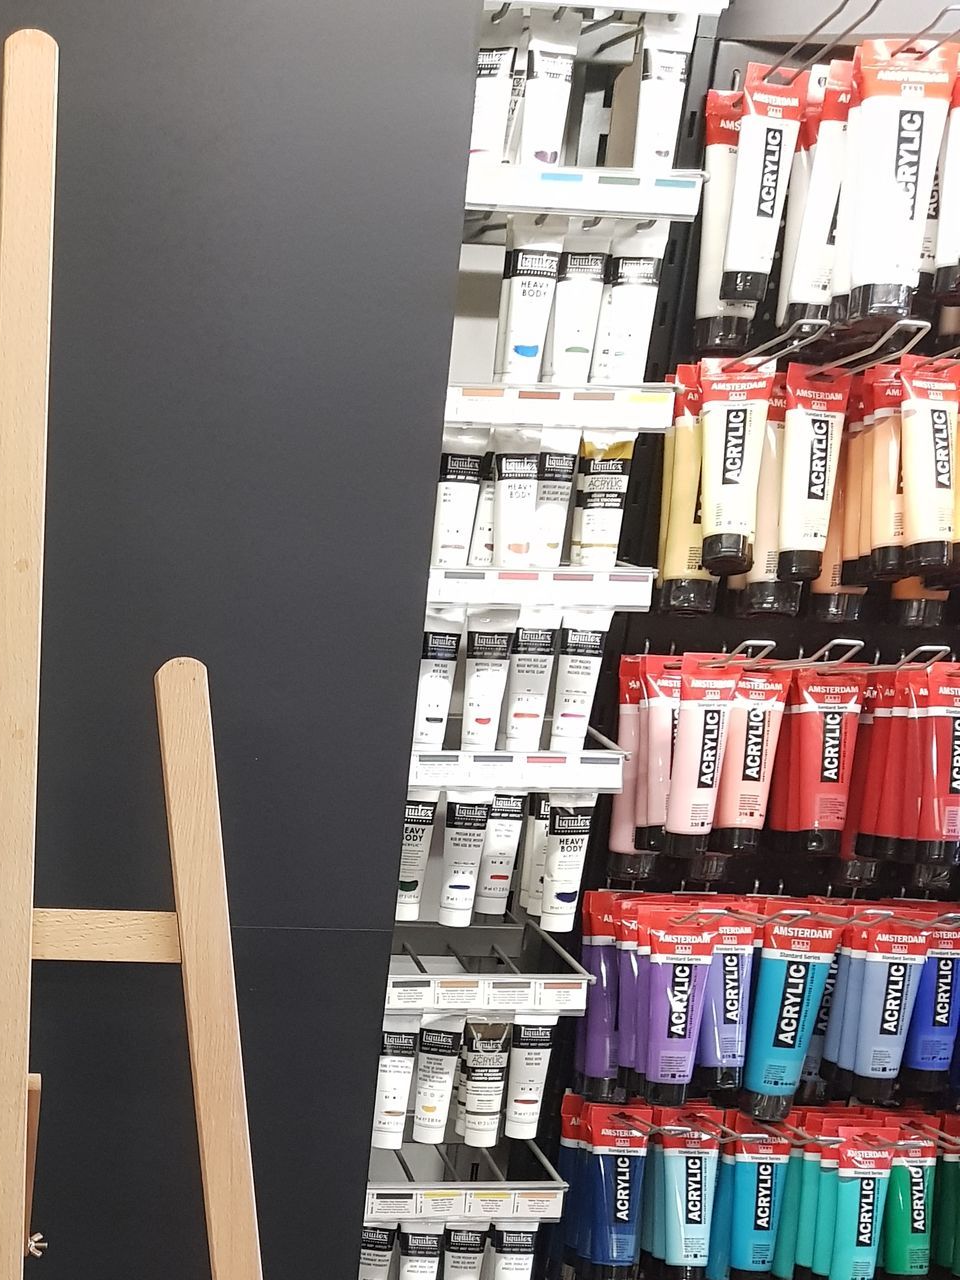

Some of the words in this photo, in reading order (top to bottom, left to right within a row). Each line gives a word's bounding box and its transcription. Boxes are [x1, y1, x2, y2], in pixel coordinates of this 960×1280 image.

[759, 130, 782, 214] ACRYLIC
[711, 381, 766, 391] AMSTERDAM
[796, 389, 843, 401] AMSTERDAM
[725, 411, 747, 483] ACRYLIC
[934, 410, 950, 486] ACRYLIC
[448, 456, 480, 469] Liquitex
[545, 454, 577, 469] Liquitex
[590, 459, 622, 472] Liquitex
[810, 420, 828, 498] ACRYLIC
[588, 480, 622, 489] ACRYLIC
[429, 634, 457, 648] Liquitex
[475, 633, 508, 648] Liquitex
[519, 628, 552, 643] Liquitex
[567, 630, 601, 644] Liquitex
[808, 686, 859, 694] AMSTERDAM
[701, 712, 720, 785] ACRYLIC
[746, 709, 765, 779] ACRYLIC
[824, 713, 841, 780] ACRYLIC
[492, 796, 522, 809] Liquitex
[455, 805, 488, 818] Liquitex
[555, 815, 591, 829] Liquitex
[659, 935, 711, 944] AMSTERDAM
[773, 926, 832, 939] AMSTERDAM
[876, 933, 926, 944] AMSTERDAM
[725, 955, 738, 1021] ACRYLIC
[935, 959, 952, 1024] ACRYLIC
[671, 965, 690, 1036] ACRYLIC
[778, 963, 806, 1044] ACRYLIC
[883, 964, 904, 1032] ACRYLIC
[384, 1033, 414, 1045] Liquitex
[422, 1031, 452, 1044] Liquitex
[520, 1027, 551, 1039] Liquitex
[472, 1056, 503, 1065] ACRYLIC
[847, 1150, 890, 1158] AMSTERDAM
[616, 1157, 630, 1221] ACRYLIC
[688, 1158, 701, 1222] ACRYLIC
[757, 1164, 772, 1228] ACRYLIC
[912, 1167, 925, 1231] ACRYLIC
[858, 1179, 874, 1244] ACRYLIC
[408, 1235, 439, 1247] Liquitex
[451, 1230, 480, 1243] Liquitex
[503, 1231, 532, 1244] Liquitex
